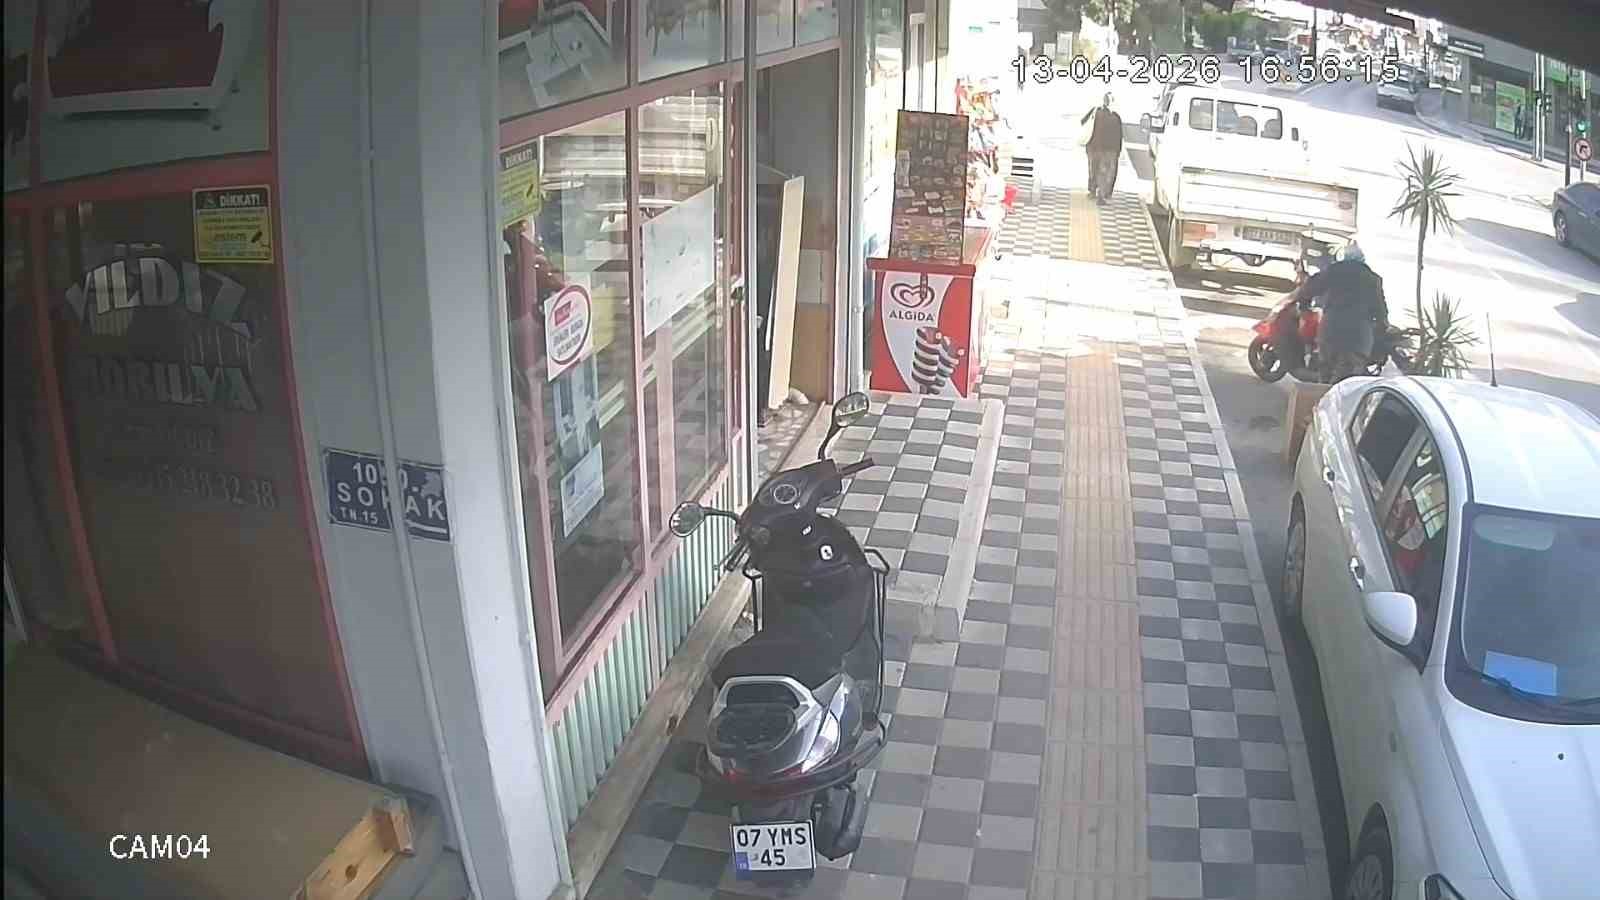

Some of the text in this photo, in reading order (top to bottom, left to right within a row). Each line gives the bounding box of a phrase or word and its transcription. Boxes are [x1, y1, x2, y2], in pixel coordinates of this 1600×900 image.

[736, 827, 807, 847] 07 YMS
[760, 849, 786, 867] 45
